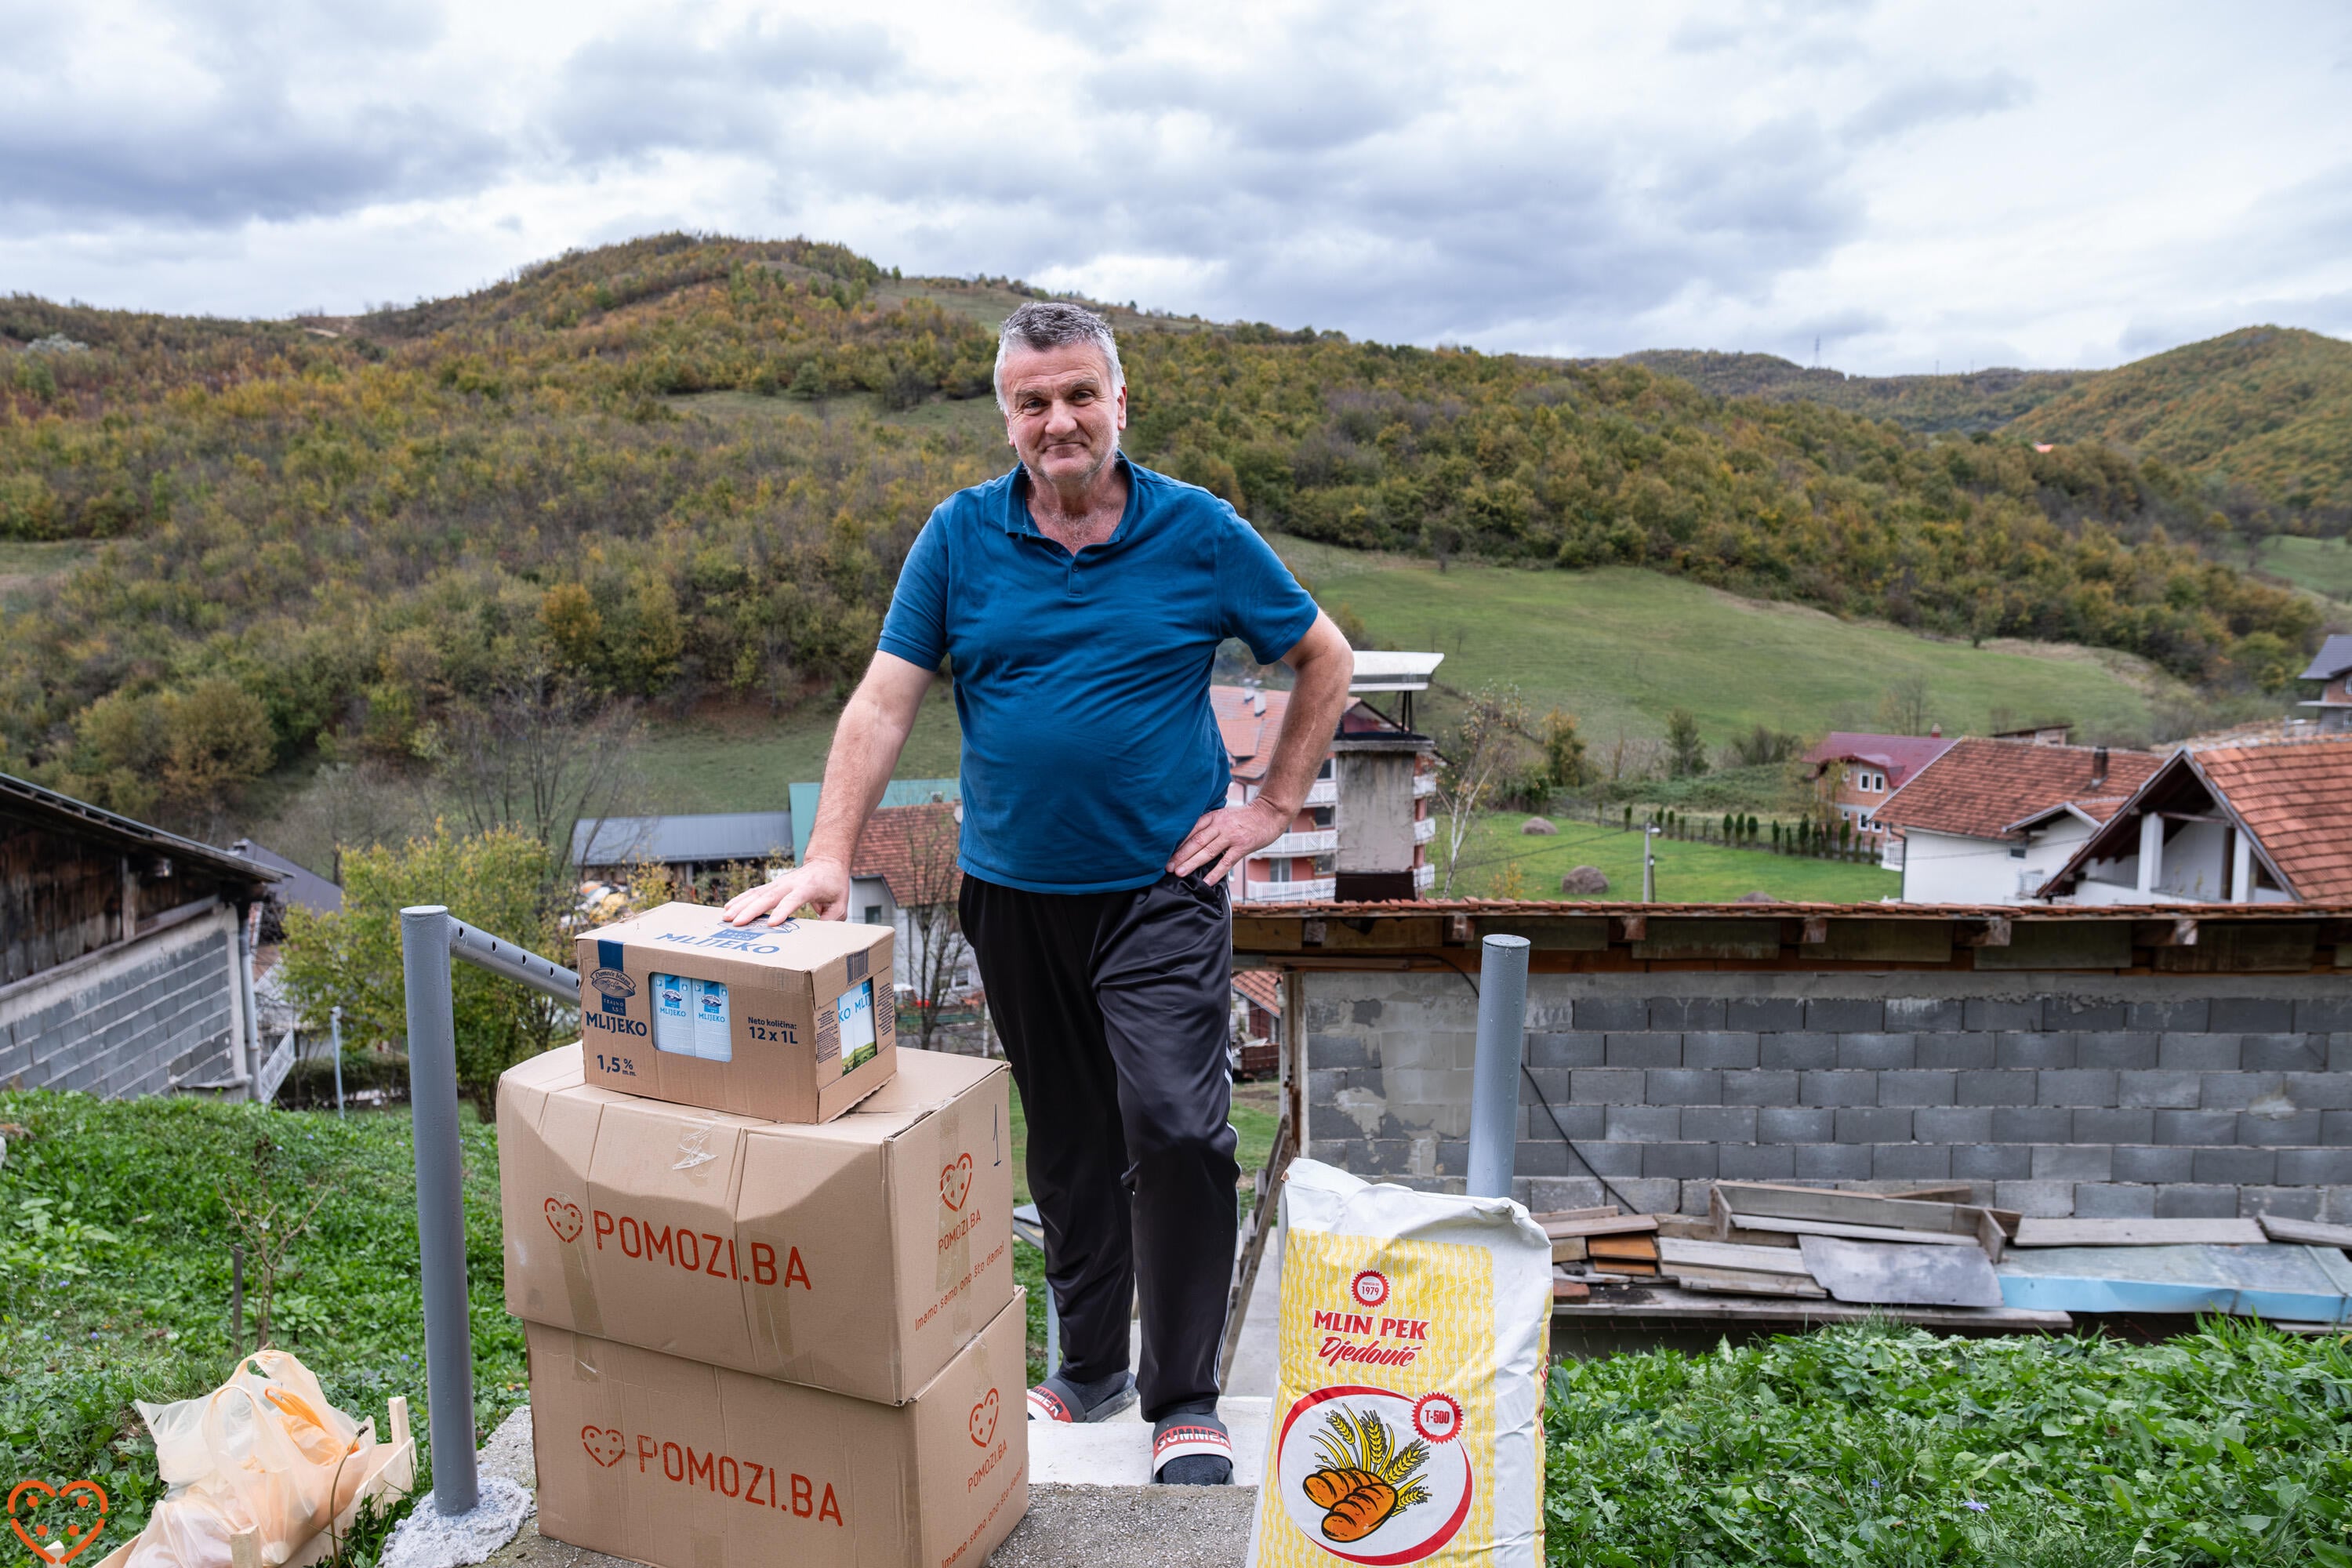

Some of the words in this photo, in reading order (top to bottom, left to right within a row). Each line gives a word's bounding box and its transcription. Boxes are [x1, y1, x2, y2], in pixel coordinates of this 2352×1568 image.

[655, 933, 780, 954] MLIJEKO
[585, 1011, 648, 1037] MLIJEKO
[659, 1007, 687, 1018] MLIJEKO
[698, 1012, 726, 1023] MLIJEKO
[748, 1016, 765, 1025] Neto
[766, 1018, 797, 1030] količina:
[749, 1025, 766, 1040] 12
[768, 1031, 779, 1042] x
[781, 1030, 799, 1044] 1L
[938, 1208, 982, 1255] POMOZI.BA
[593, 1210, 812, 1290] POMOZI.BA
[915, 1304, 938, 1331] Imamo
[940, 1285, 958, 1309] samo
[960, 1272, 972, 1290] ono
[974, 1261, 985, 1278] što
[986, 1240, 1004, 1266] damo!
[1361, 1286, 1380, 1296] 1979
[1313, 1309, 1374, 1335] MLIN
[1380, 1317, 1430, 1341] PEK
[1318, 1336, 1422, 1367] Djedović
[1424, 1409, 1450, 1425] T-500
[1157, 1428, 1232, 1451] SUMMER
[967, 1438, 1007, 1494] POMOZI.BA
[637, 1434, 844, 1527] POMOZI.BA
[942, 1541, 967, 1568] Imamo
[969, 1519, 986, 1544] samo
[988, 1502, 1000, 1522] ono
